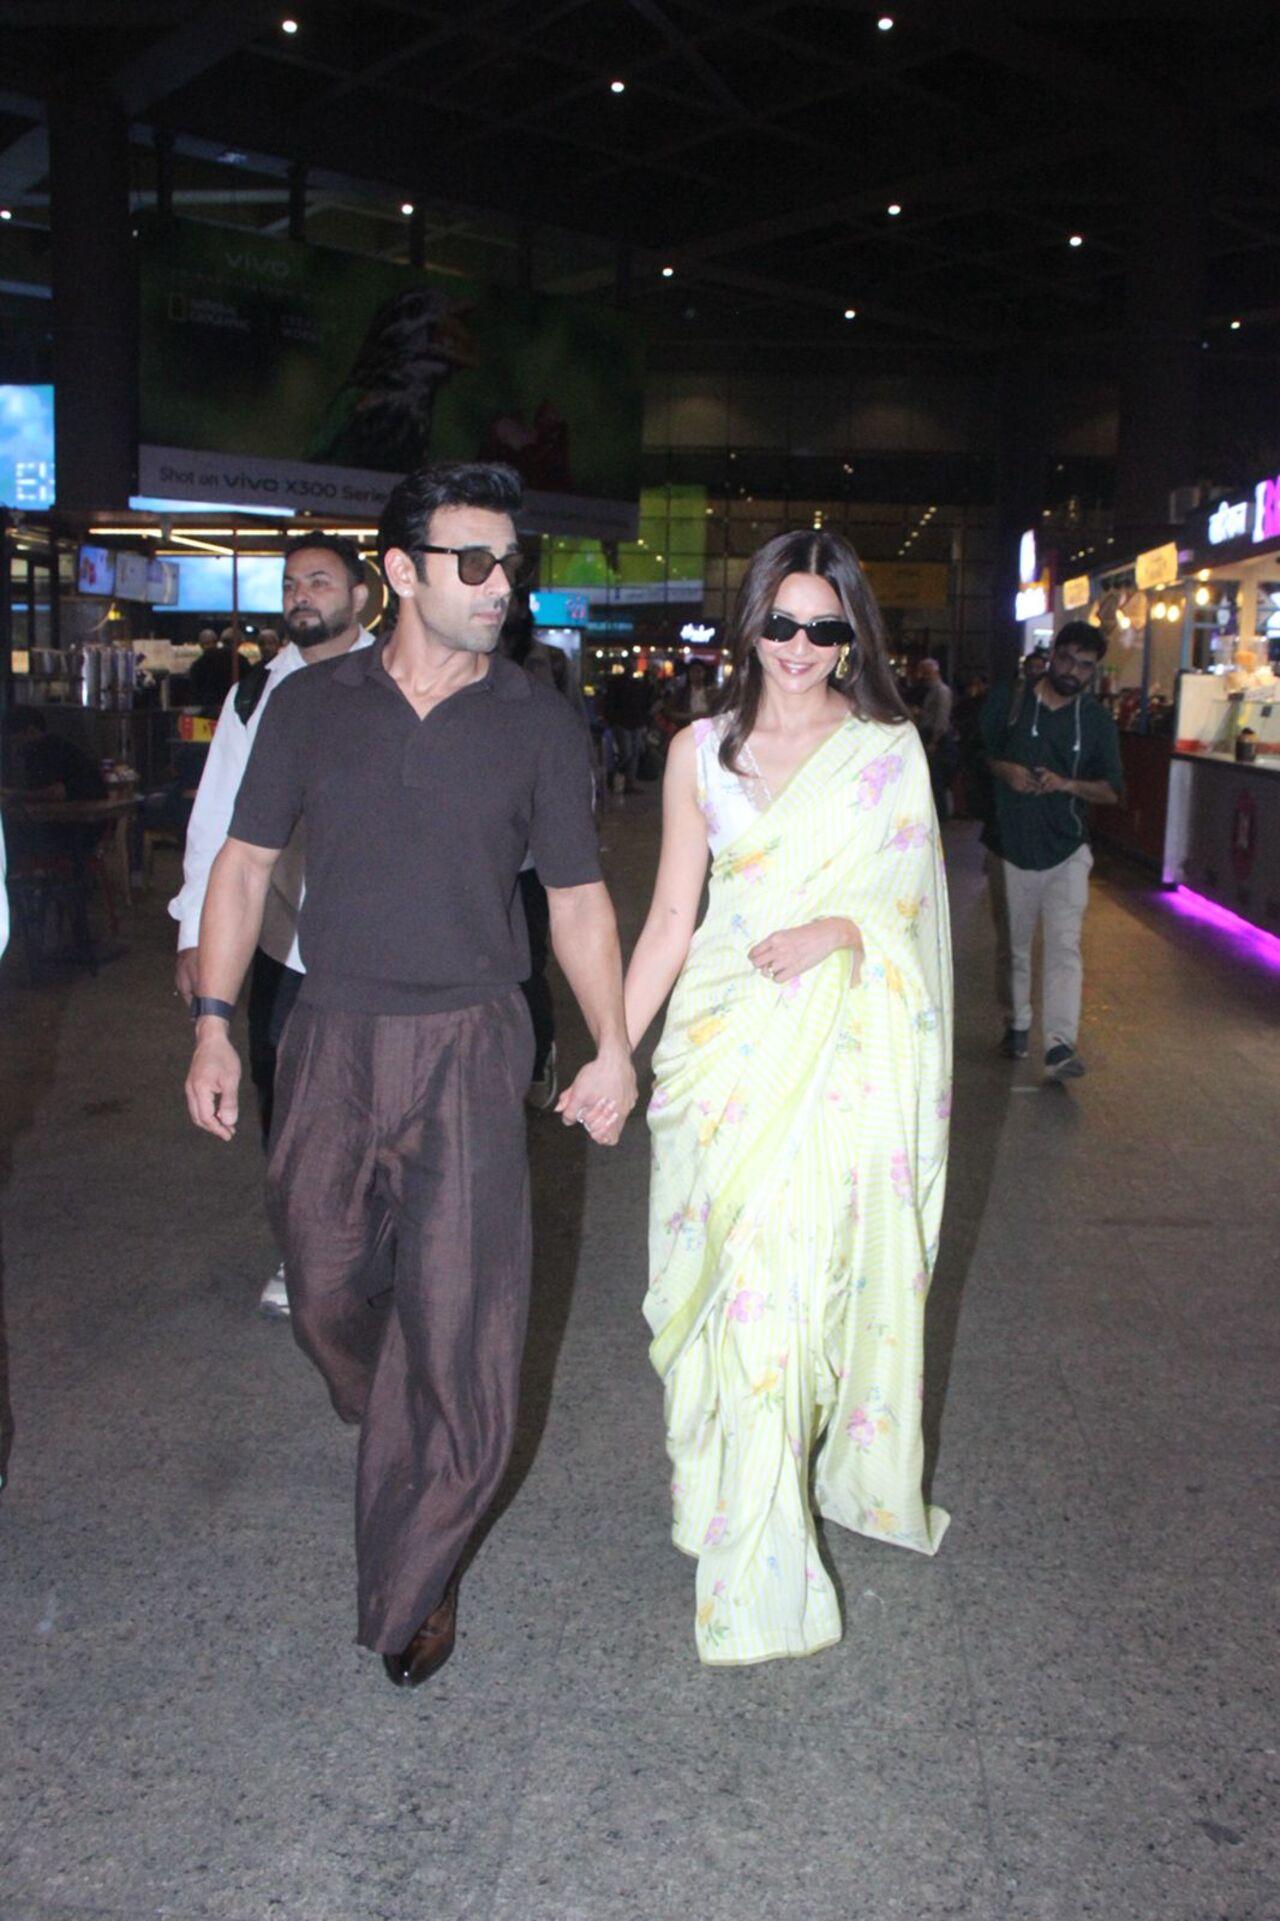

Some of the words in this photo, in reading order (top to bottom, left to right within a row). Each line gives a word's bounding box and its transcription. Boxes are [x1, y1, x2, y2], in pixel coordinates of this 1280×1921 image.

[160, 466, 194, 485] Shot
[198, 473, 219, 487] on
[223, 472, 279, 493] vivo
[285, 479, 337, 498] X300
